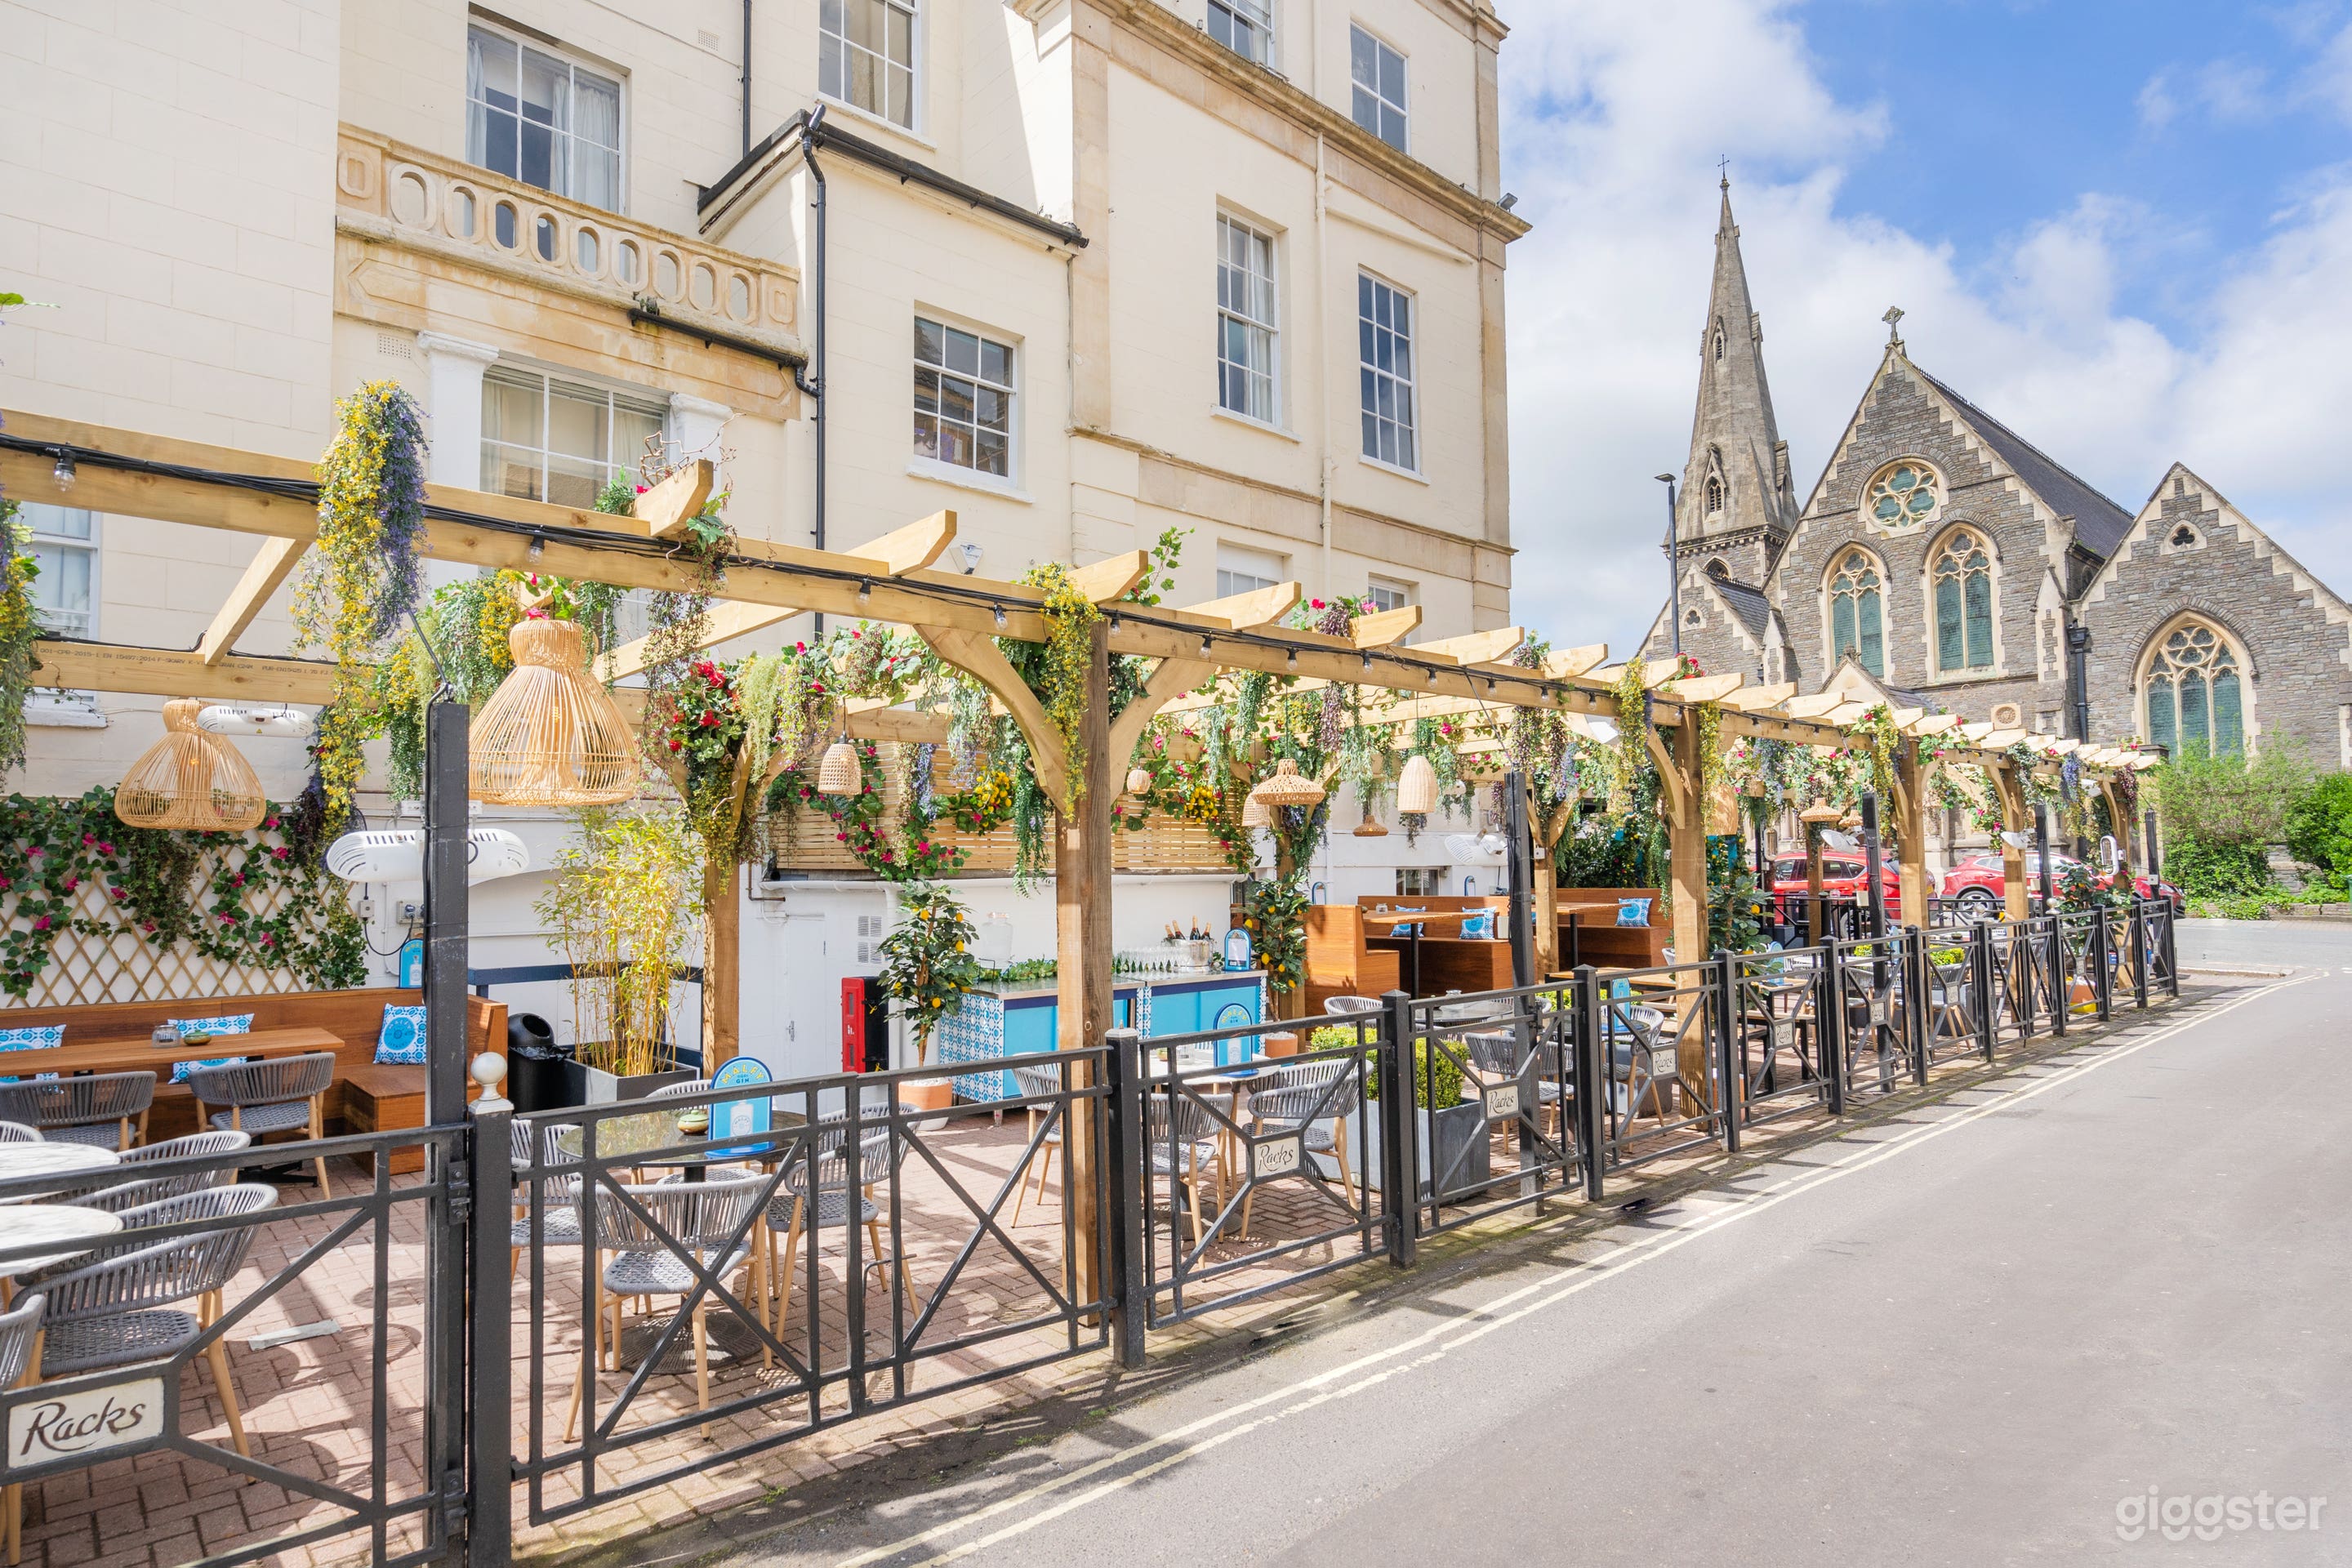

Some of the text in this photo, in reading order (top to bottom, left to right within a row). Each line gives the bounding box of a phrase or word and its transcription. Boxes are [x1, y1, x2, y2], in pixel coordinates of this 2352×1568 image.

[721, 1064, 765, 1085] MALFY
[1489, 1091, 1514, 1114] Racks
[1258, 1144, 1294, 1172] Racks
[20, 1396, 145, 1455] Racks
